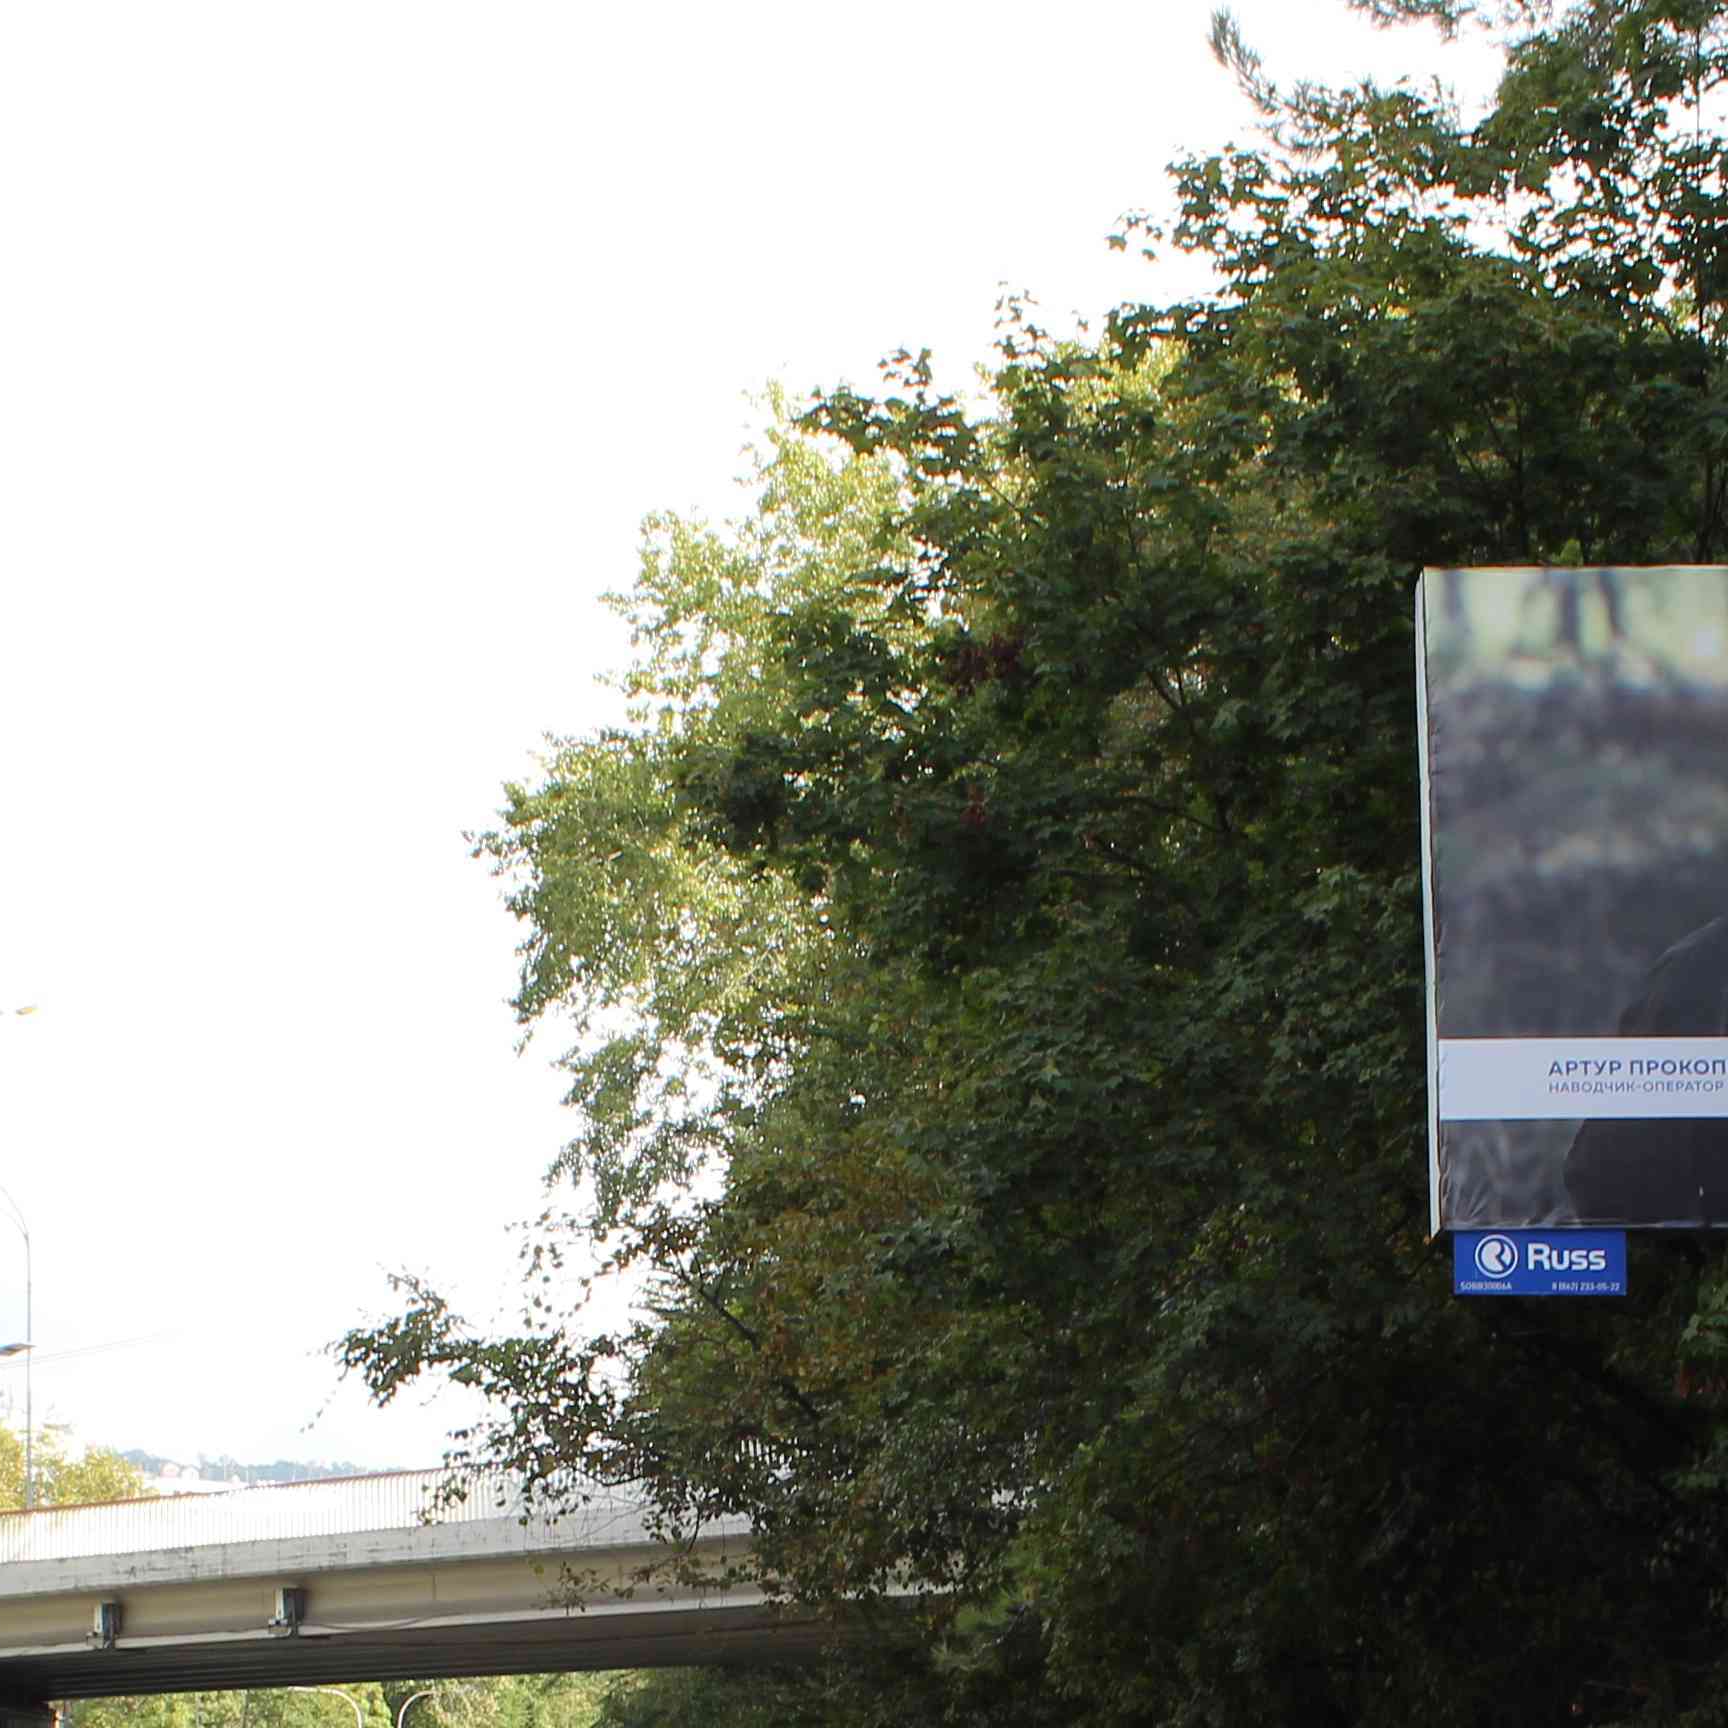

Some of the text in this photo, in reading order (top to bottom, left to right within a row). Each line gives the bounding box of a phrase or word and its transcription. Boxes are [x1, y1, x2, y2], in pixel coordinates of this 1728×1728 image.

[1548, 1059, 1622, 1077] АРТУР
[1548, 1079, 1725, 1095] НАВОДЧИК-ОПЕРАТОР
[1527, 1243, 1606, 1271] Russ
